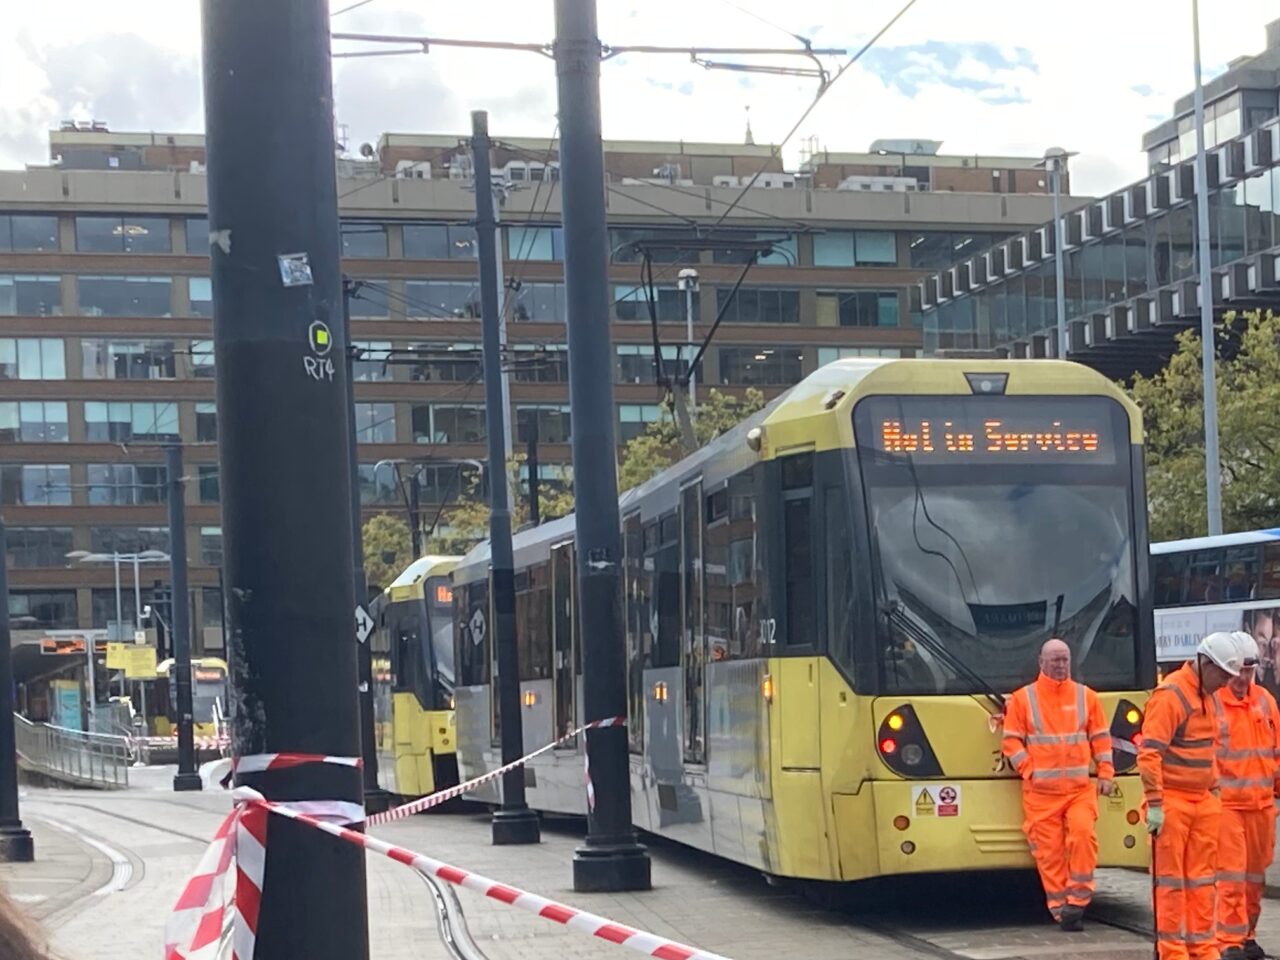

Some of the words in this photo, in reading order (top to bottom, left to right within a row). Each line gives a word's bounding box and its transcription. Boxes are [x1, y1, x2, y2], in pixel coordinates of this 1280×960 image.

[303, 356, 335, 382] RT4
[883, 421, 934, 451] Not
[944, 421, 974, 451] in
[984, 421, 1098, 451] Service
